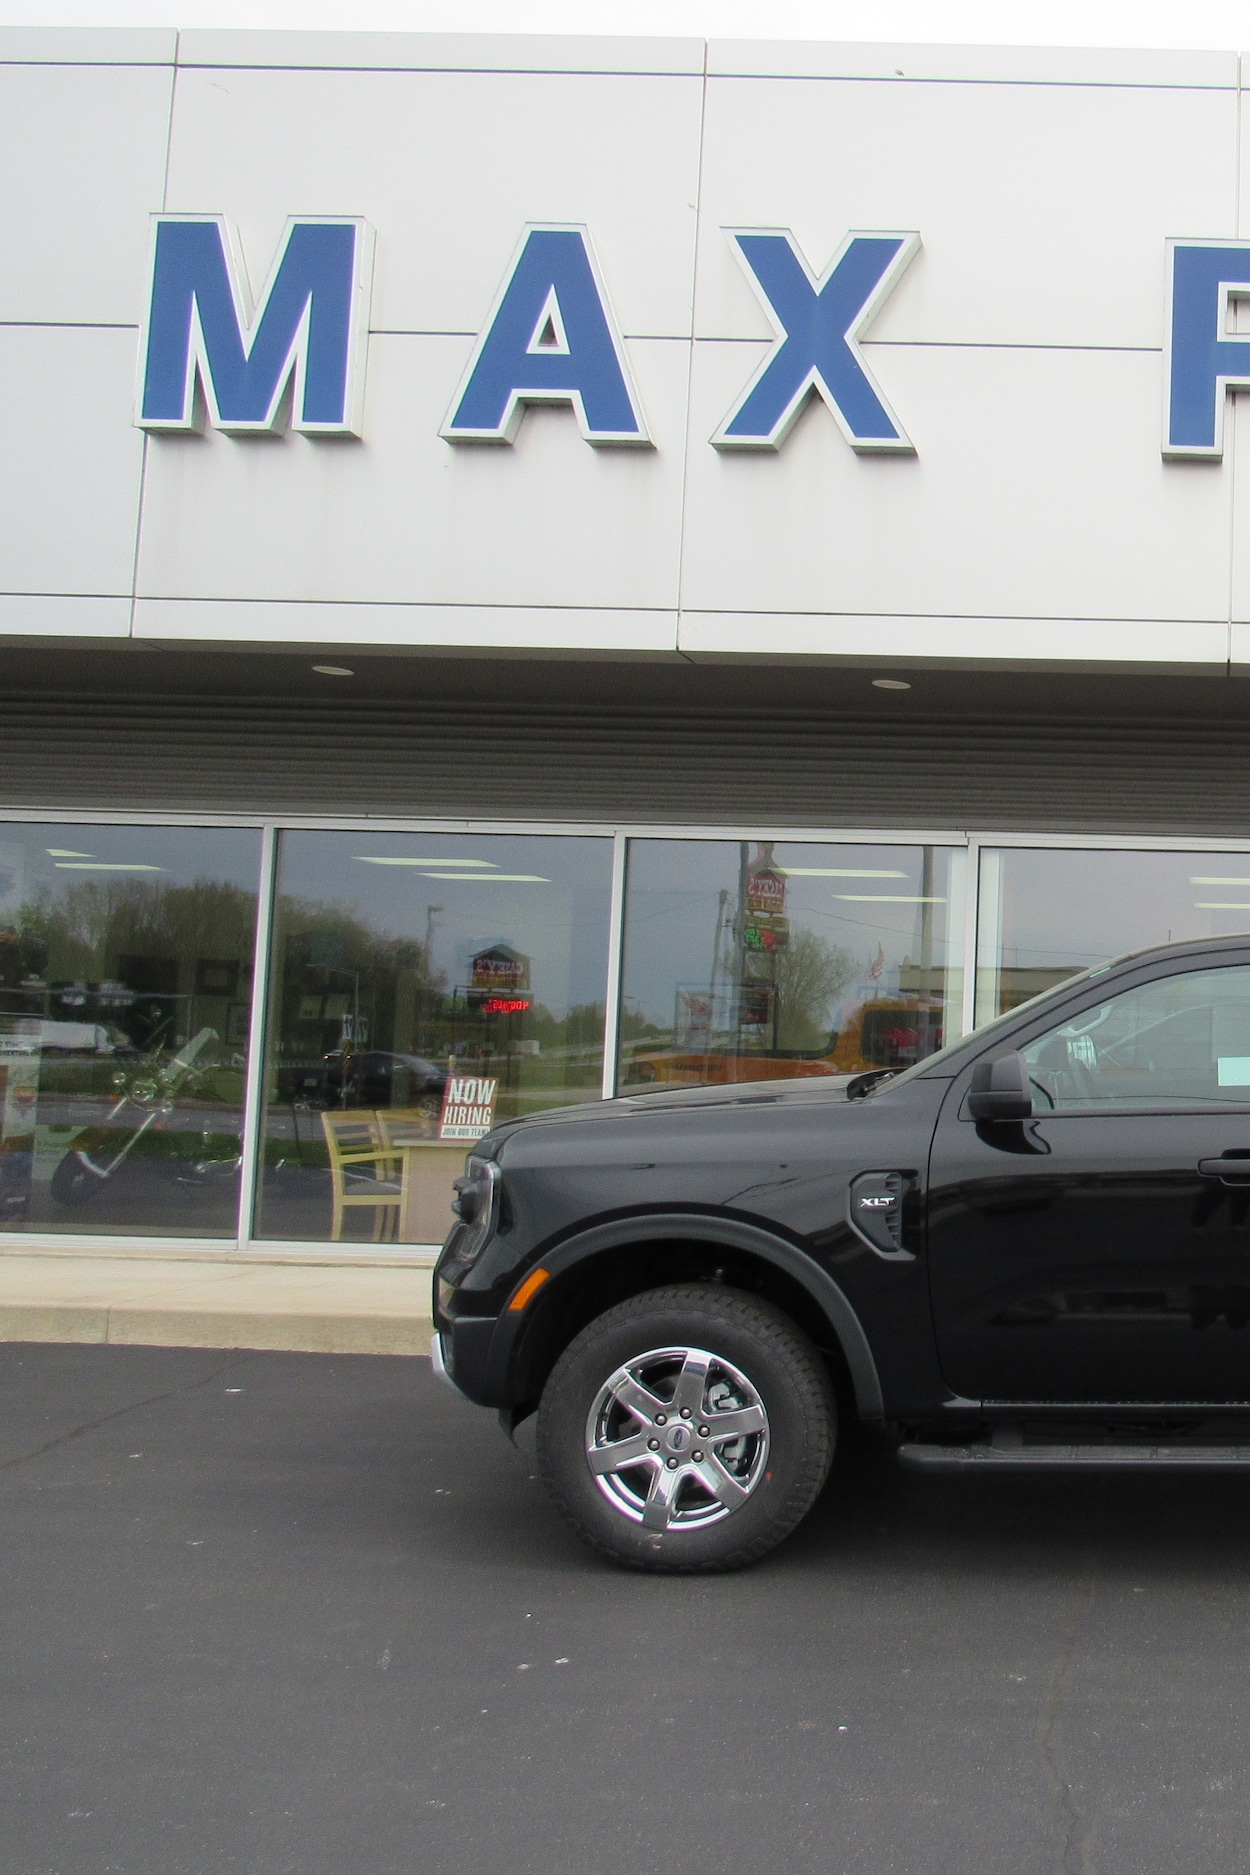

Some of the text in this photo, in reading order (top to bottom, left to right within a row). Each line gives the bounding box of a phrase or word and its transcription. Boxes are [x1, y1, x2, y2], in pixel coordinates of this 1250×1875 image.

[137, 213, 921, 452] MAX
[448, 1079, 496, 1105] NOW
[443, 1106, 491, 1125] HIRING
[443, 1128, 456, 1136] JOIN
[458, 1128, 469, 1136] OUR
[860, 1197, 895, 1207] XLT
